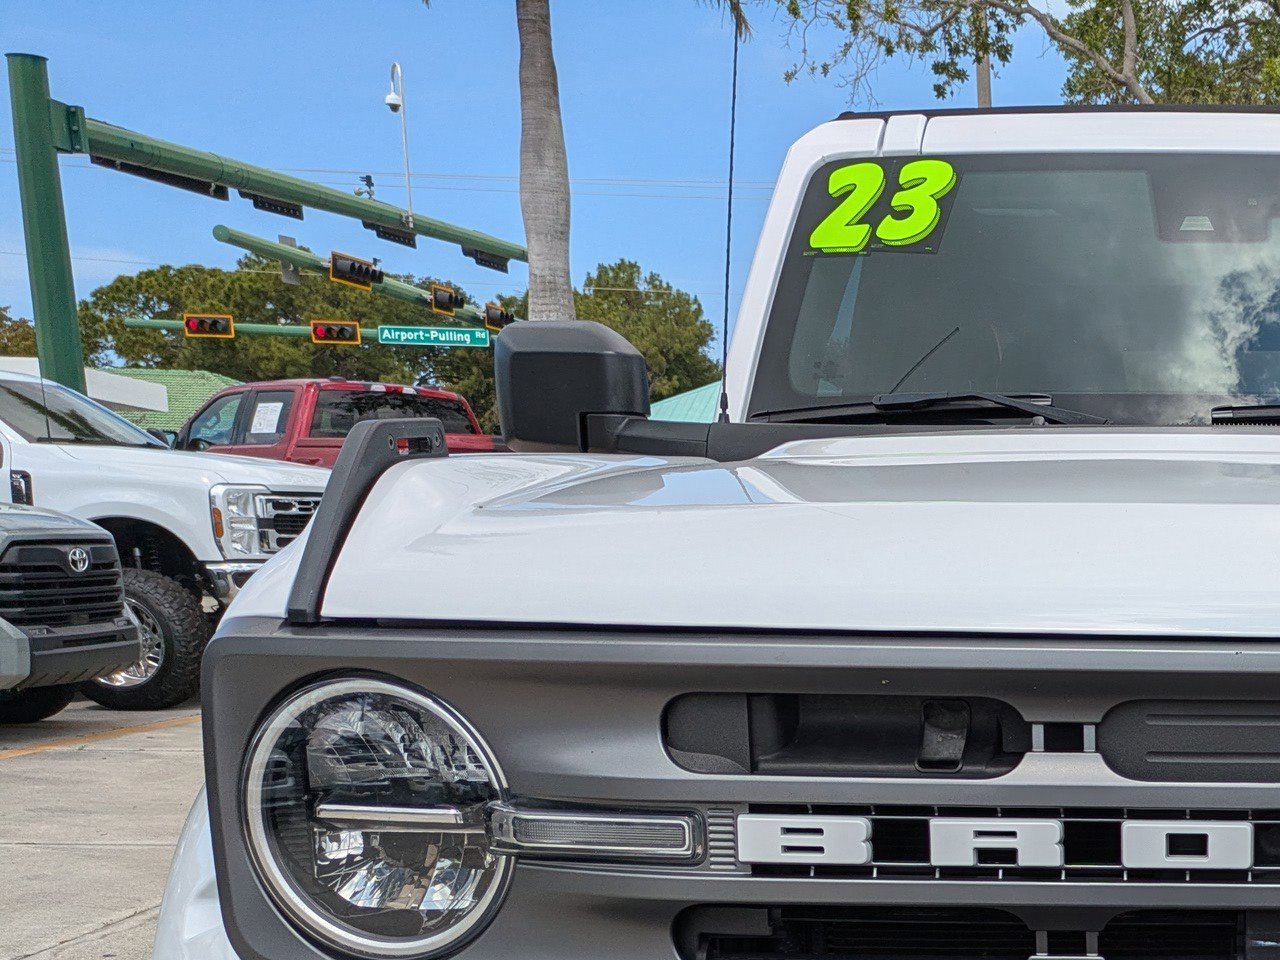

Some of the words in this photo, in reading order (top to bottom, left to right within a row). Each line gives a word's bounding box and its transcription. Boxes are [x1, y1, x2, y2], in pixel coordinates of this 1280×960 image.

[810, 159, 957, 254] 23
[382, 329, 471, 344] Airport-Pulling
[475, 331, 486, 339] Rd
